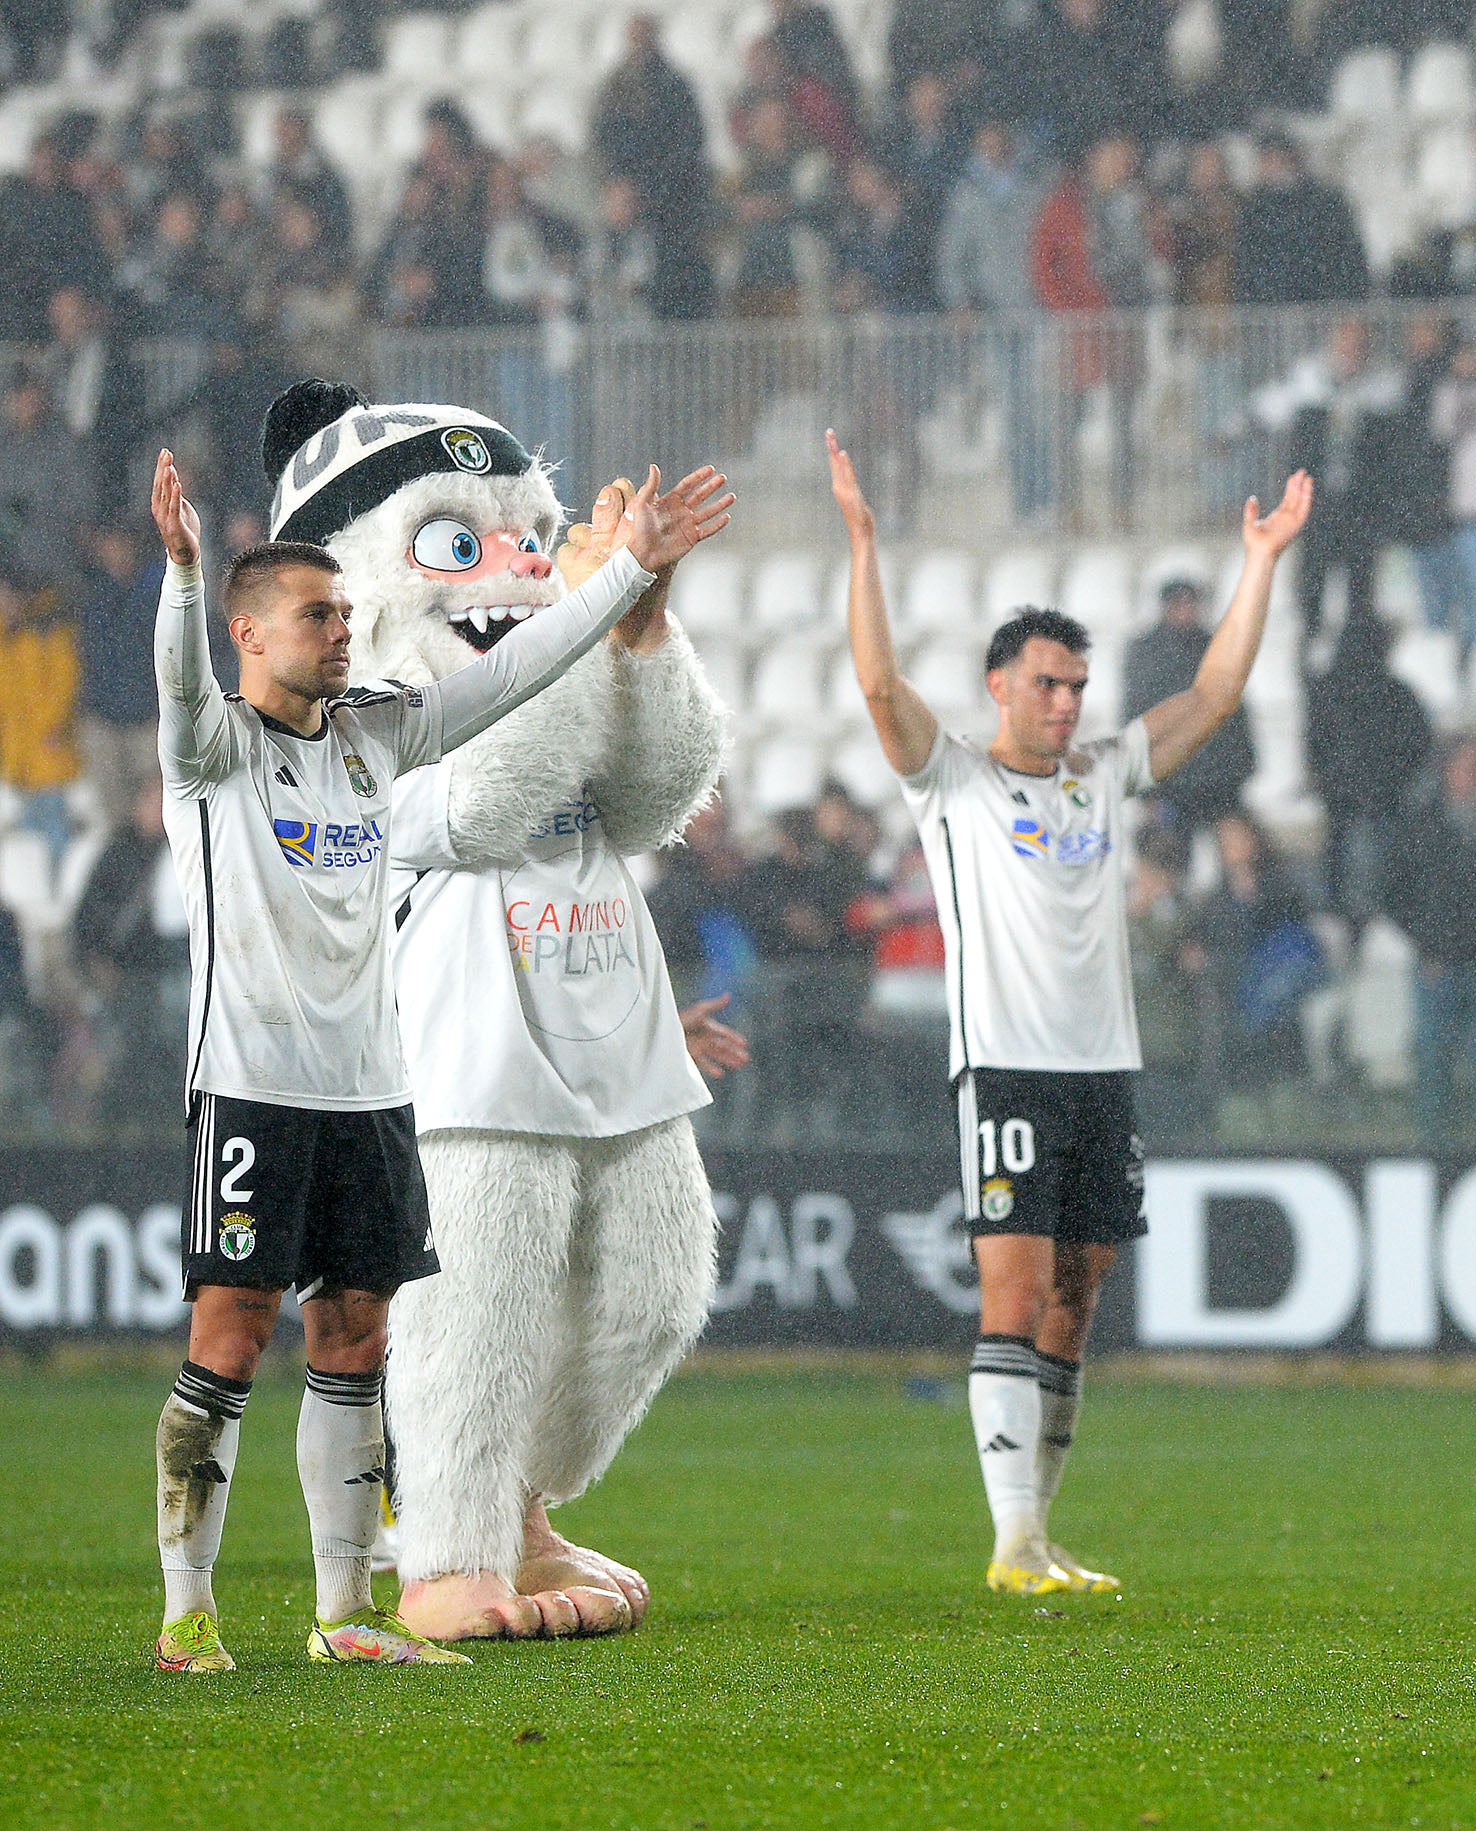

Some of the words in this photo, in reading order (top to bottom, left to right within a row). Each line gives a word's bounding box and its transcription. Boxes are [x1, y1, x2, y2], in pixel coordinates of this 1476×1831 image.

[506, 898, 626, 933] CAMINO
[534, 932, 635, 974] PLATA
[220, 1136, 256, 1203] 2
[978, 1117, 1036, 1174] 10
[713, 1191, 862, 1312] AR
